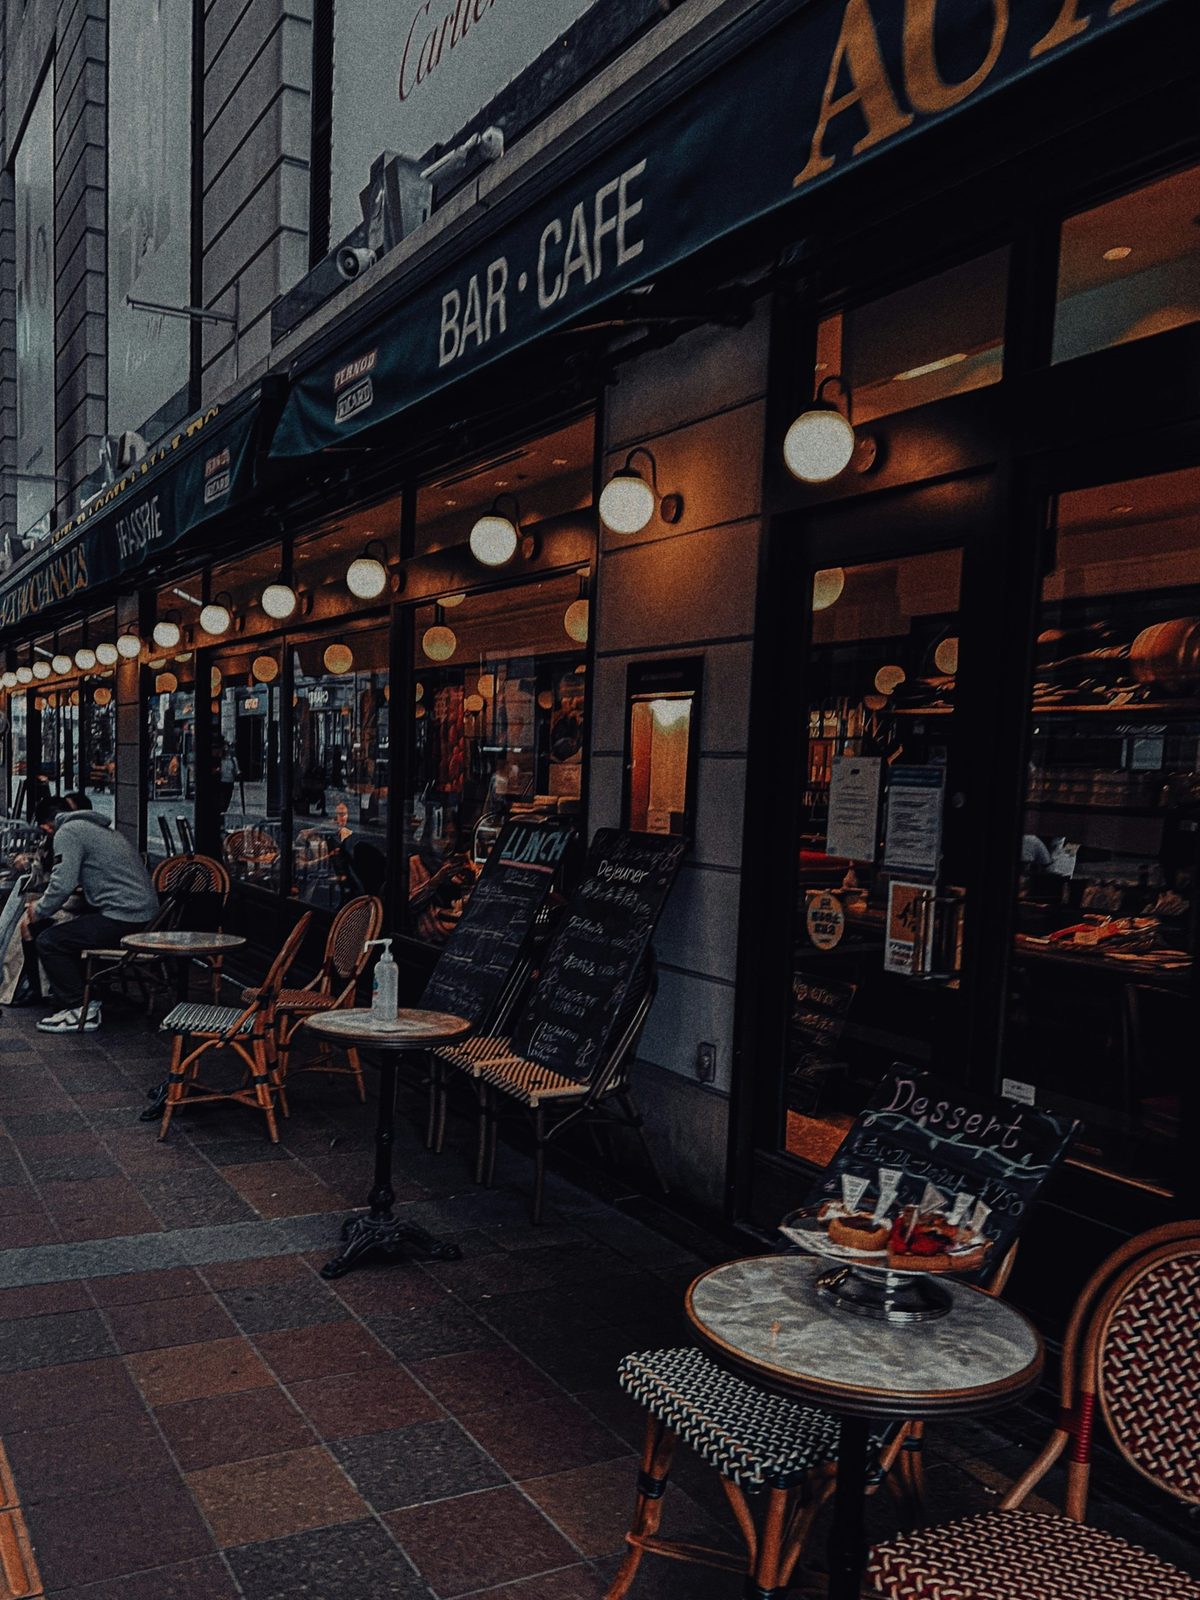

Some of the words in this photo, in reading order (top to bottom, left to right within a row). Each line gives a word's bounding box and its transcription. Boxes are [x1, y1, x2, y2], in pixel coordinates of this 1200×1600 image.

[792, 0, 1142, 188] AU
[438, 256, 508, 368] BAR
[537, 157, 648, 310] CAFE
[500, 826, 572, 862] LUNCH
[597, 860, 649, 884] Dejeuner
[881, 1077, 1023, 1150] Dessert
